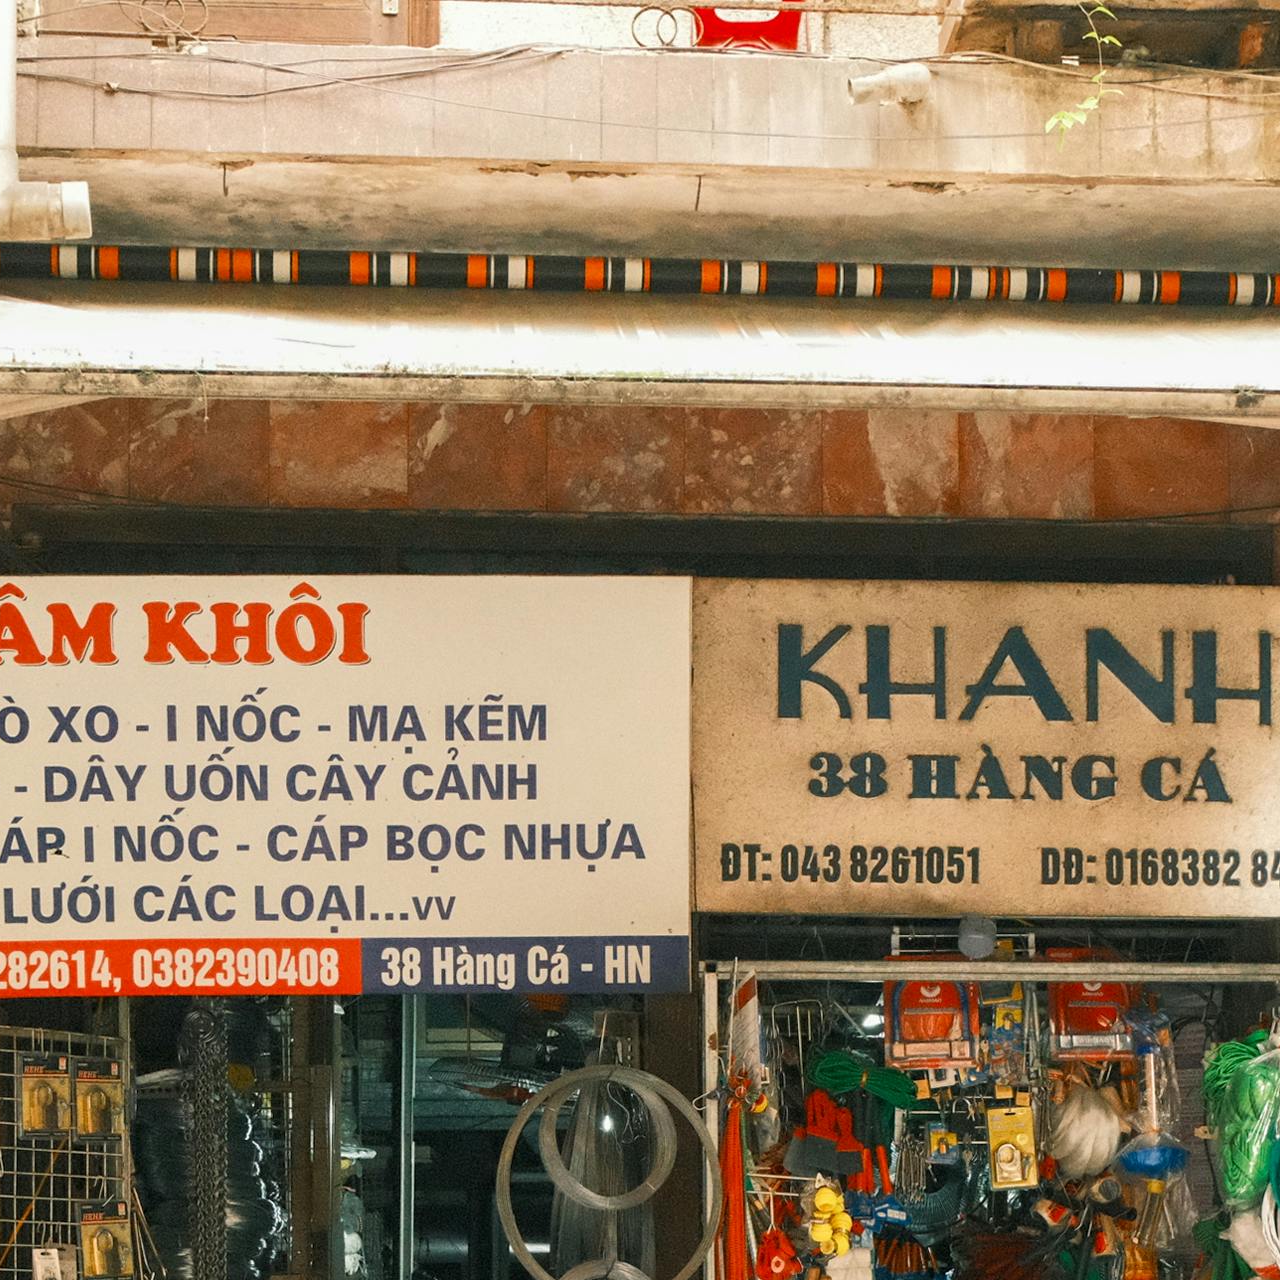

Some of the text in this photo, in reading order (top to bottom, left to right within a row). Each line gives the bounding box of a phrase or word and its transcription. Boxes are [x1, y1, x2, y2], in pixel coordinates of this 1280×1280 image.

[142, 582, 371, 666] KHÔI
[778, 624, 1272, 726] KHANH
[48, 706, 120, 743] XO
[167, 705, 177, 742] I
[197, 687, 301, 742] NỐC
[348, 705, 427, 754] MẠ
[445, 694, 547, 741] KẼM
[44, 755, 147, 803] DÂY
[164, 746, 269, 802] UỐN
[286, 755, 388, 801] CÂY
[402, 746, 538, 801] CẢNH
[809, 743, 1232, 804] 38 HÀNG CÁ
[83, 827, 93, 863] I
[119, 808, 220, 863] NỐC
[266, 814, 368, 862] CÁP
[386, 824, 486, 874] BỌC
[504, 818, 646, 873] NHỰA
[721, 844, 980, 885] ĐT: 043 8261051
[1041, 847, 1097, 886] DĐ:
[1106, 848, 1240, 889] 0168382
[3, 875, 115, 924] LƯỚI
[133, 875, 236, 923] CÁC
[132, 947, 340, 988] 0382390408
[380, 947, 421, 987] 38
[432, 944, 517, 991] Hàng
[526, 944, 570, 986] Cá
[604, 944, 652, 984] HN
